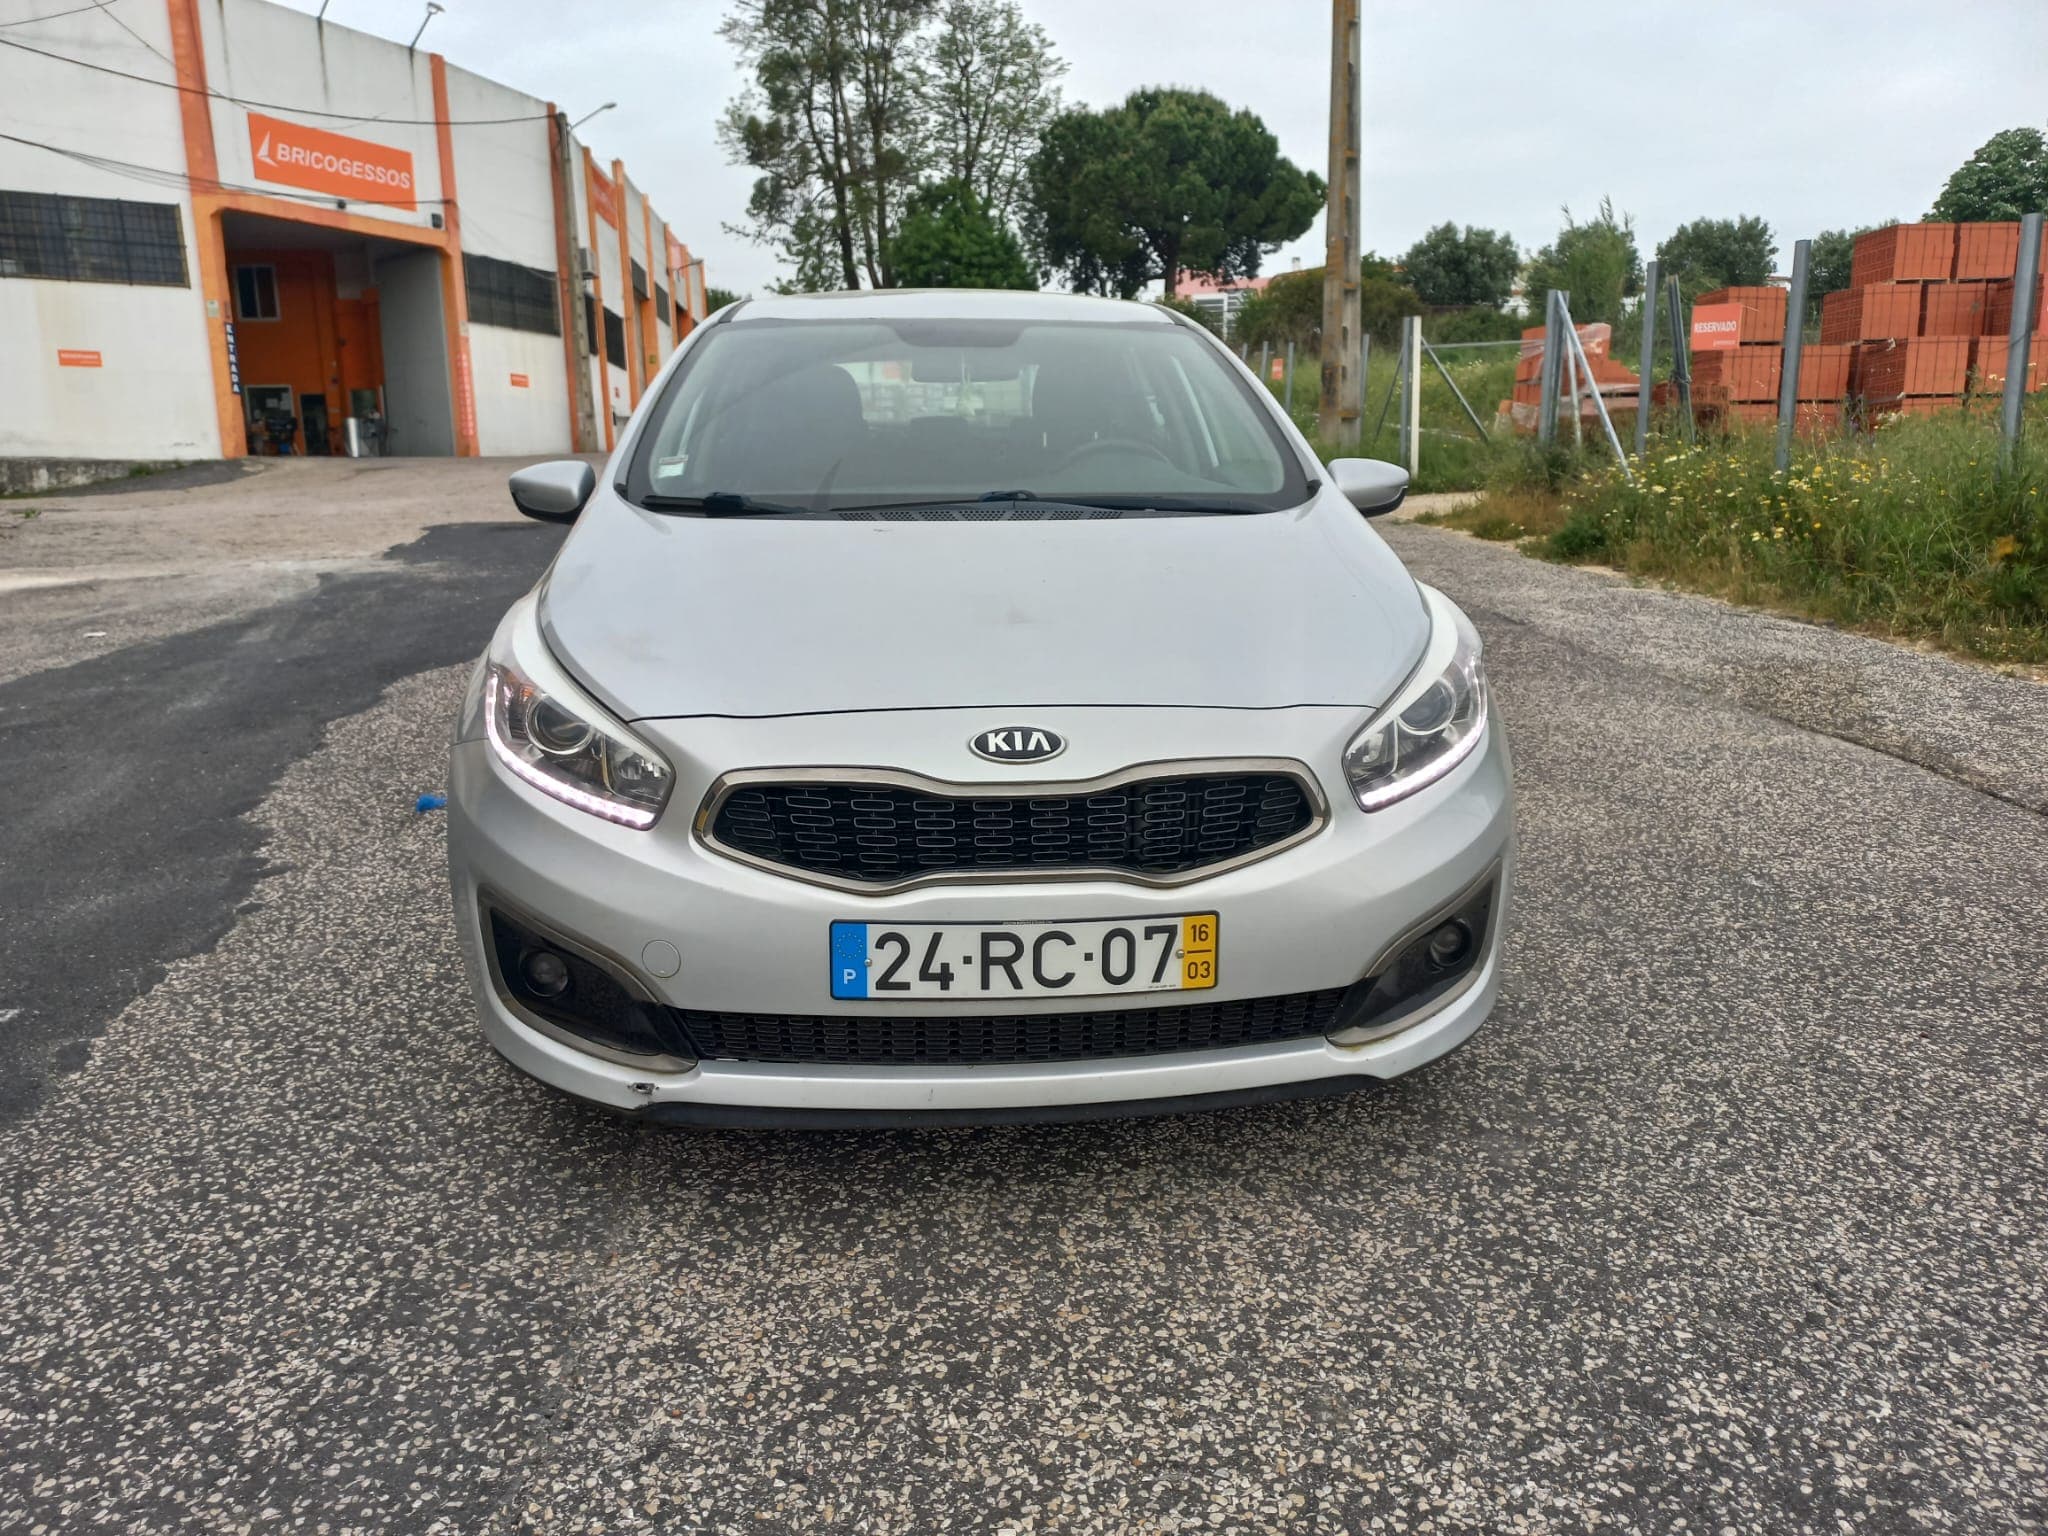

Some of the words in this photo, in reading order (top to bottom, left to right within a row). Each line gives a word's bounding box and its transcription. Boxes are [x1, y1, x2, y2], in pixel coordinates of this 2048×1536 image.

[277, 143, 411, 189] BRICOGESSOS
[1694, 320, 1737, 333] RESERVADO
[226, 323, 240, 393] ENTRADA
[987, 731, 1051, 753] KIA
[1190, 923, 1209, 943] 16
[843, 968, 857, 985] P
[1187, 960, 1211, 980] 03
